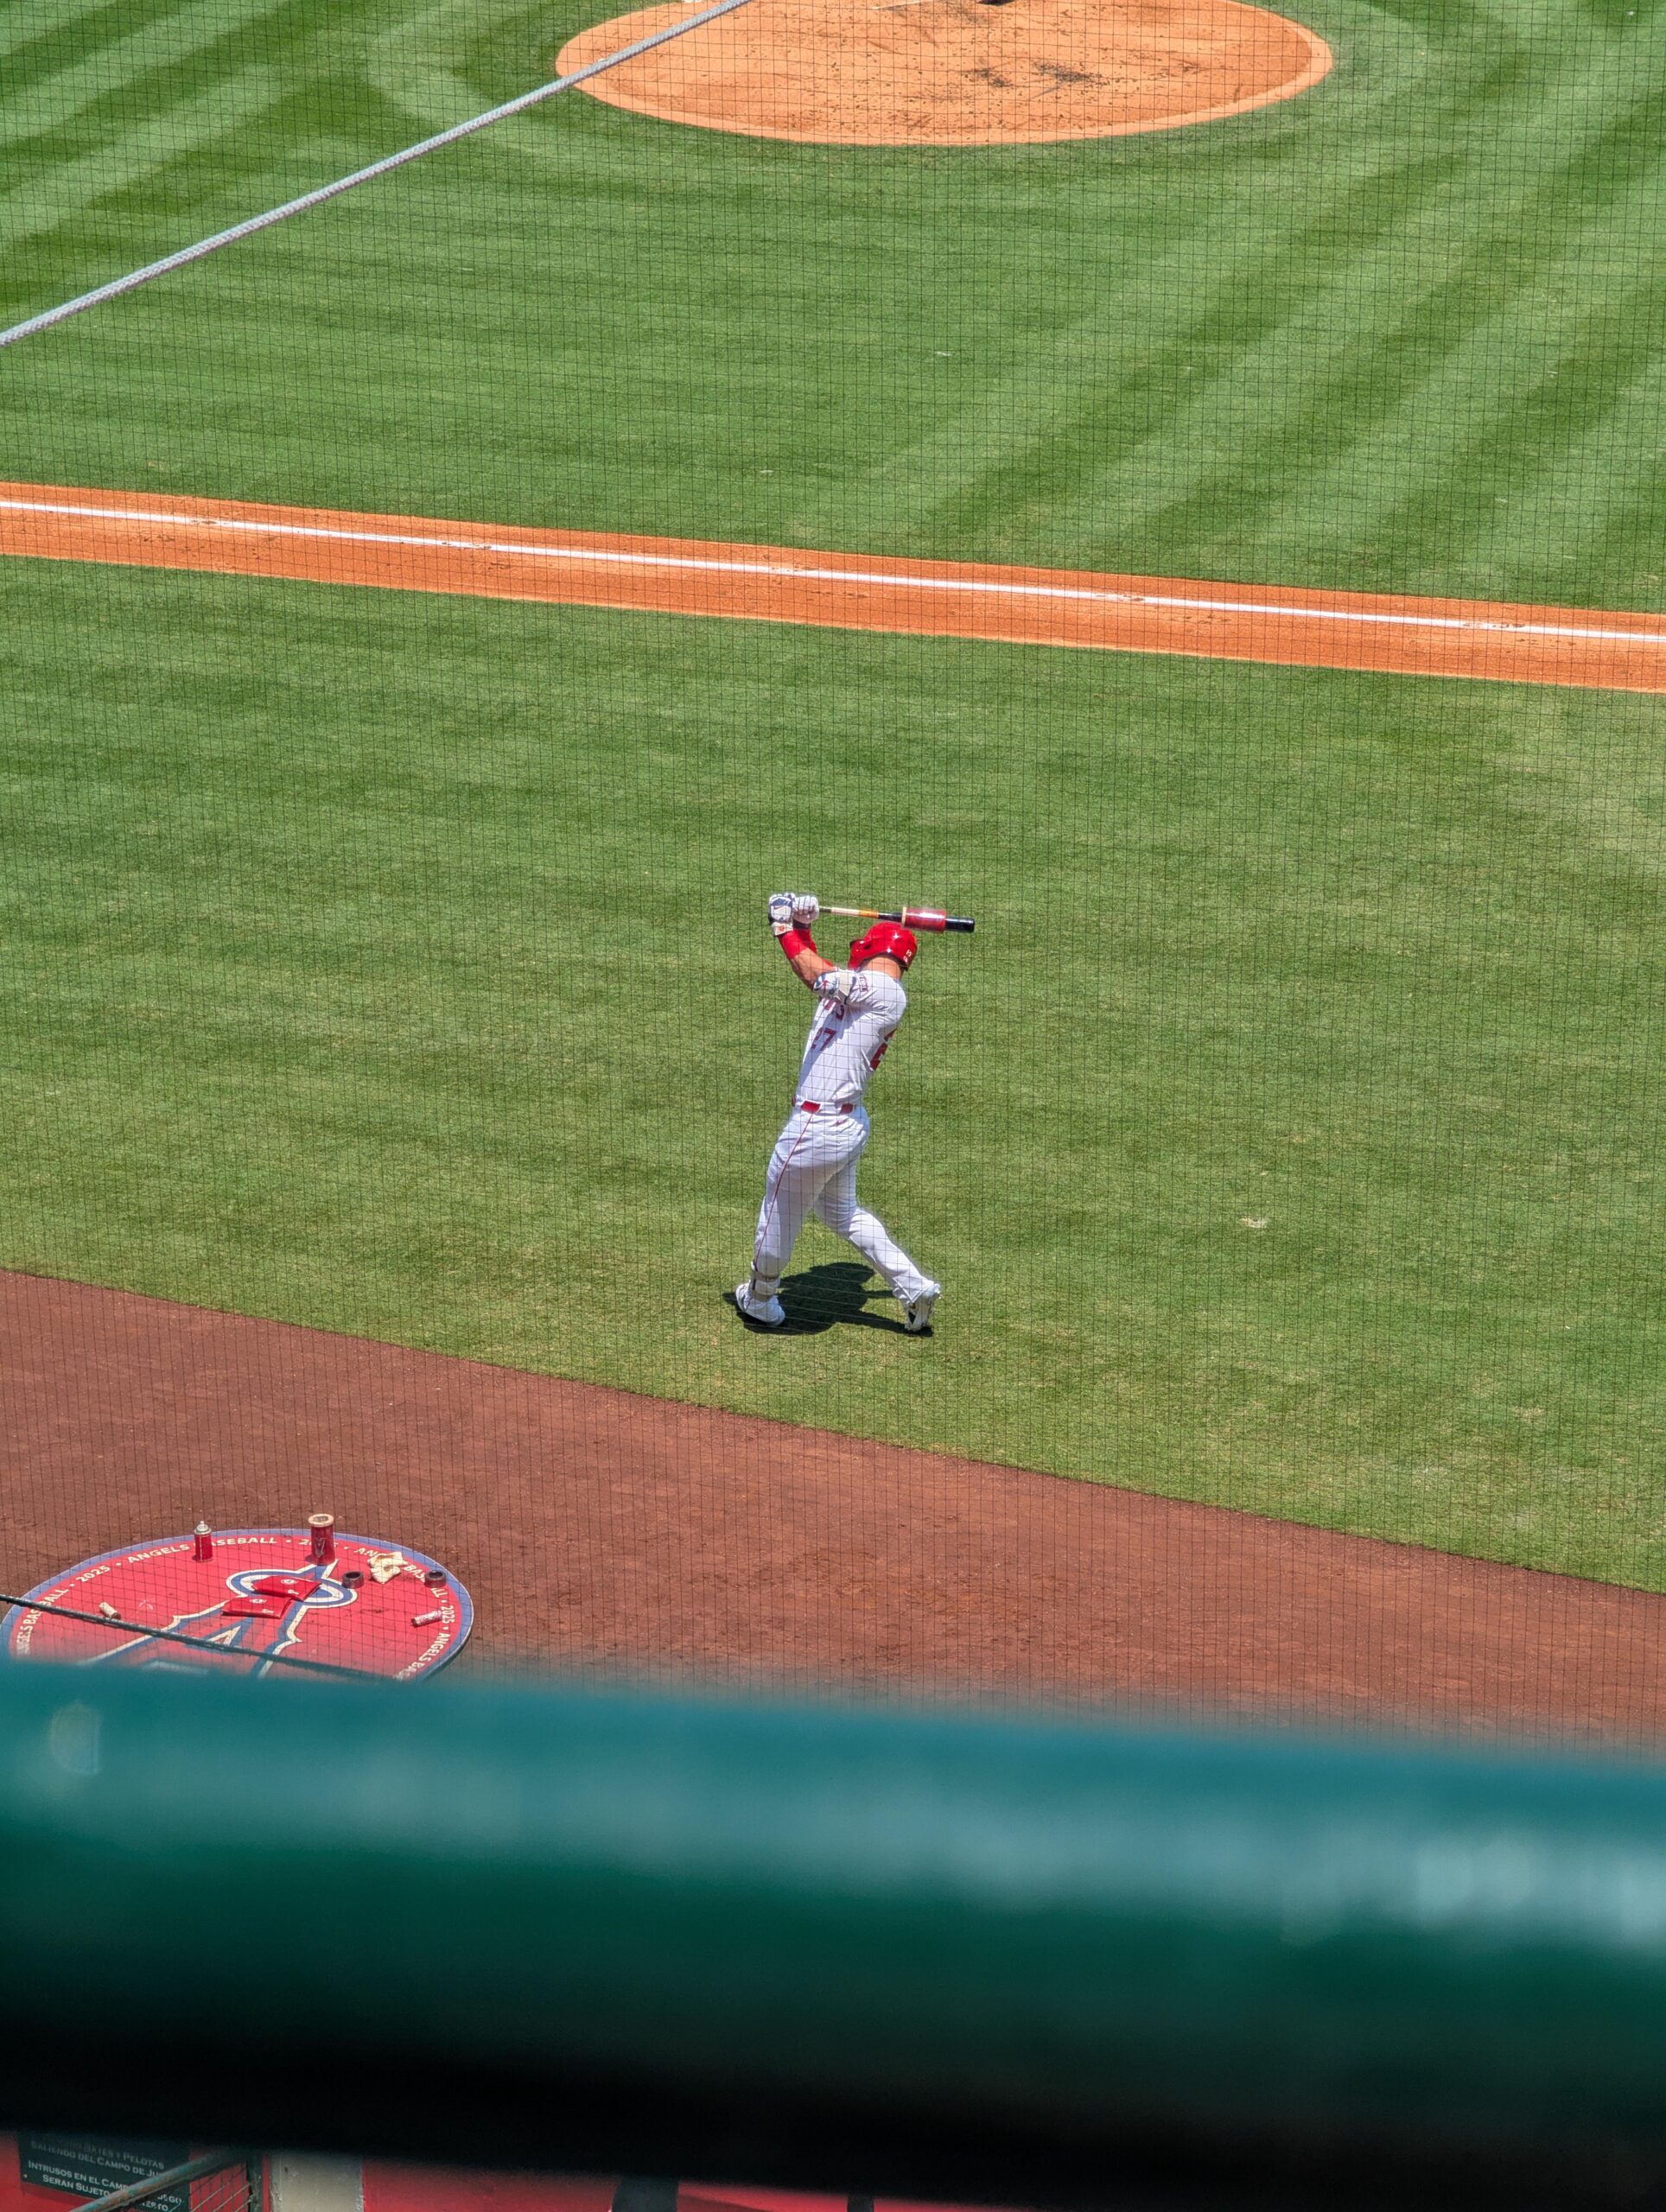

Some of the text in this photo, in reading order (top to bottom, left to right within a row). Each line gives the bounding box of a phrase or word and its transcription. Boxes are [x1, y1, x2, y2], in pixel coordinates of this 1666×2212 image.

[194, 1536, 277, 1547] SEBALL
[128, 1543, 190, 1563] ANGELS
[76, 1565, 111, 1582] 2025
[22, 1589, 68, 1624] BASBALL
[441, 1605, 455, 1624] 2025
[418, 1632, 451, 1662] ANGELS
[78, 2153, 96, 2164] DEL
[97, 2157, 130, 2172] CAMPO
[132, 2166, 145, 2176] DE
[123, 2152, 165, 2170] PELOTAS
[28, 2160, 73, 2178] INTRUSOS
[74, 2172, 86, 2182] EN
[89, 2177, 100, 2185] EL
[101, 2178, 129, 2190] CAMP
[42, 2174, 73, 2189] SERAN
[75, 2183, 111, 2196] SUJETO
